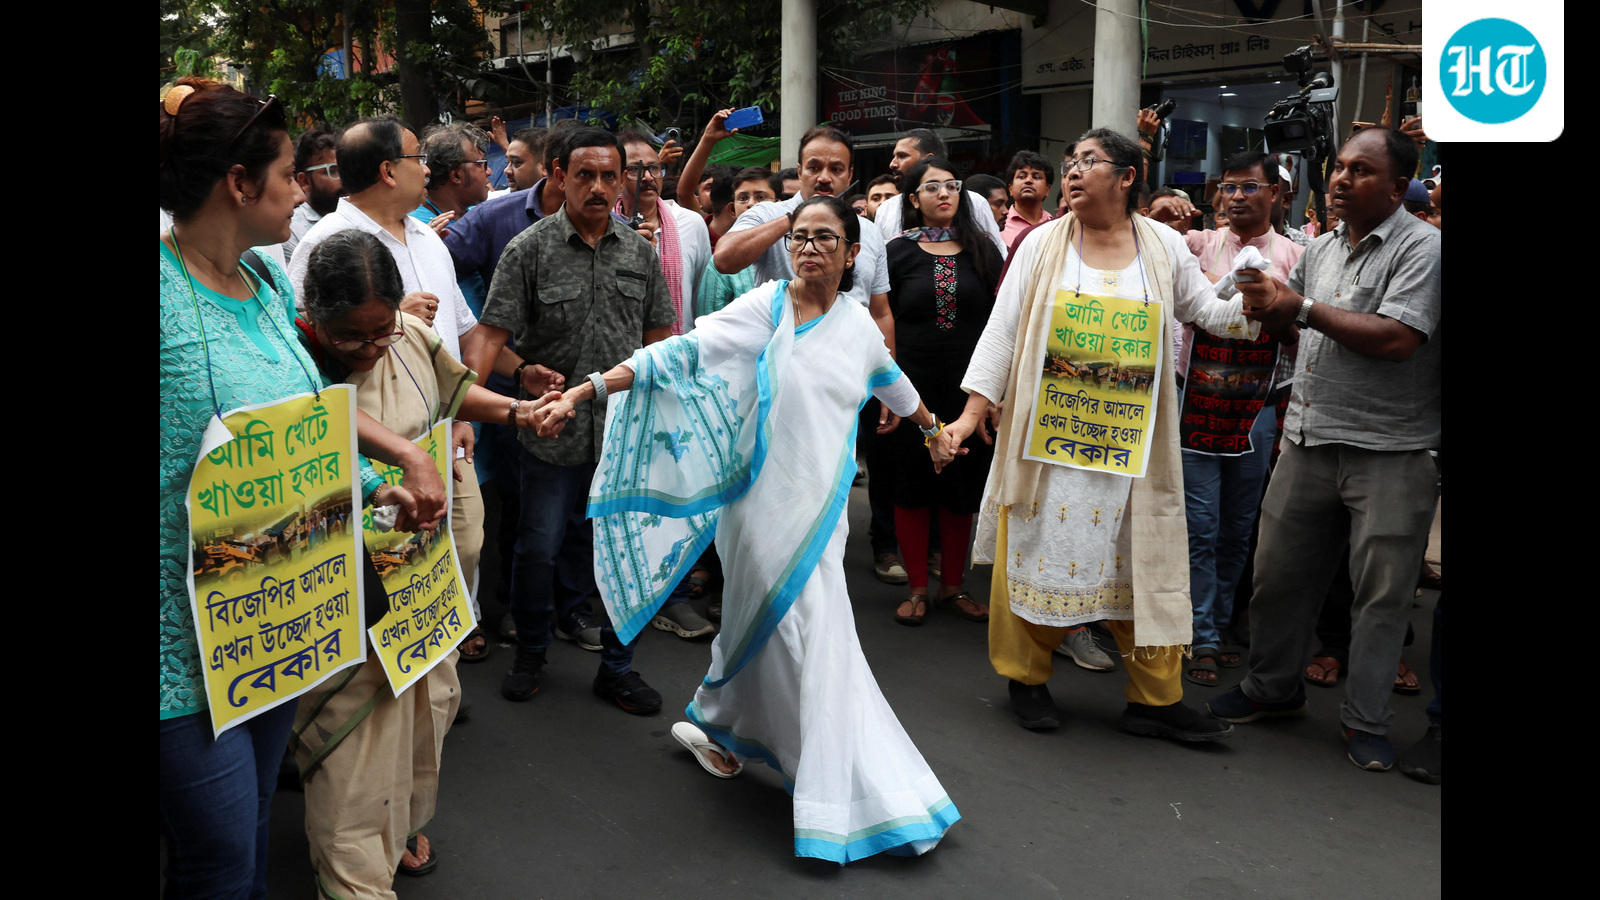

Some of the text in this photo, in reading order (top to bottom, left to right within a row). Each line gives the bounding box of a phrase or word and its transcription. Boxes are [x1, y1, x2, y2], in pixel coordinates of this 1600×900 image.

[1060, 57, 1086, 71] এইচ.
[1141, 46, 1169, 63] দ্দিন
[1172, 43, 1215, 60] টাইমস্
[1219, 41, 1240, 55] প্রাঃ
[1247, 35, 1270, 52] লিঃ
[838, 86, 887, 103] THE KING
[831, 105, 896, 122] GOOD TIMES
[1065, 300, 1149, 332] আমি খেটে
[1055, 326, 1152, 358] খাওয়া হকার
[1195, 343, 1273, 366] খাওয়া হকার
[1045, 383, 1145, 421] বিজেপির আমলে
[1187, 388, 1232, 413] বিজেপির
[207, 405, 329, 469] আমি খেটে
[1039, 413, 1143, 446] এখন উচ্ছেদ হওয়া
[1188, 431, 1249, 451] বেকার
[1045, 436, 1132, 468] বেকার
[198, 469, 285, 518] খাওয়া
[289, 451, 340, 497] হকার
[205, 553, 347, 632] বিজেপির আমলে
[386, 573, 432, 614] জেপির
[210, 588, 350, 671] এখন উচ্ছেদ হওয়া
[380, 618, 410, 648] এখন
[440, 577, 459, 609] হওয়া
[397, 606, 462, 674] বেকার
[227, 628, 342, 708] বেকার
